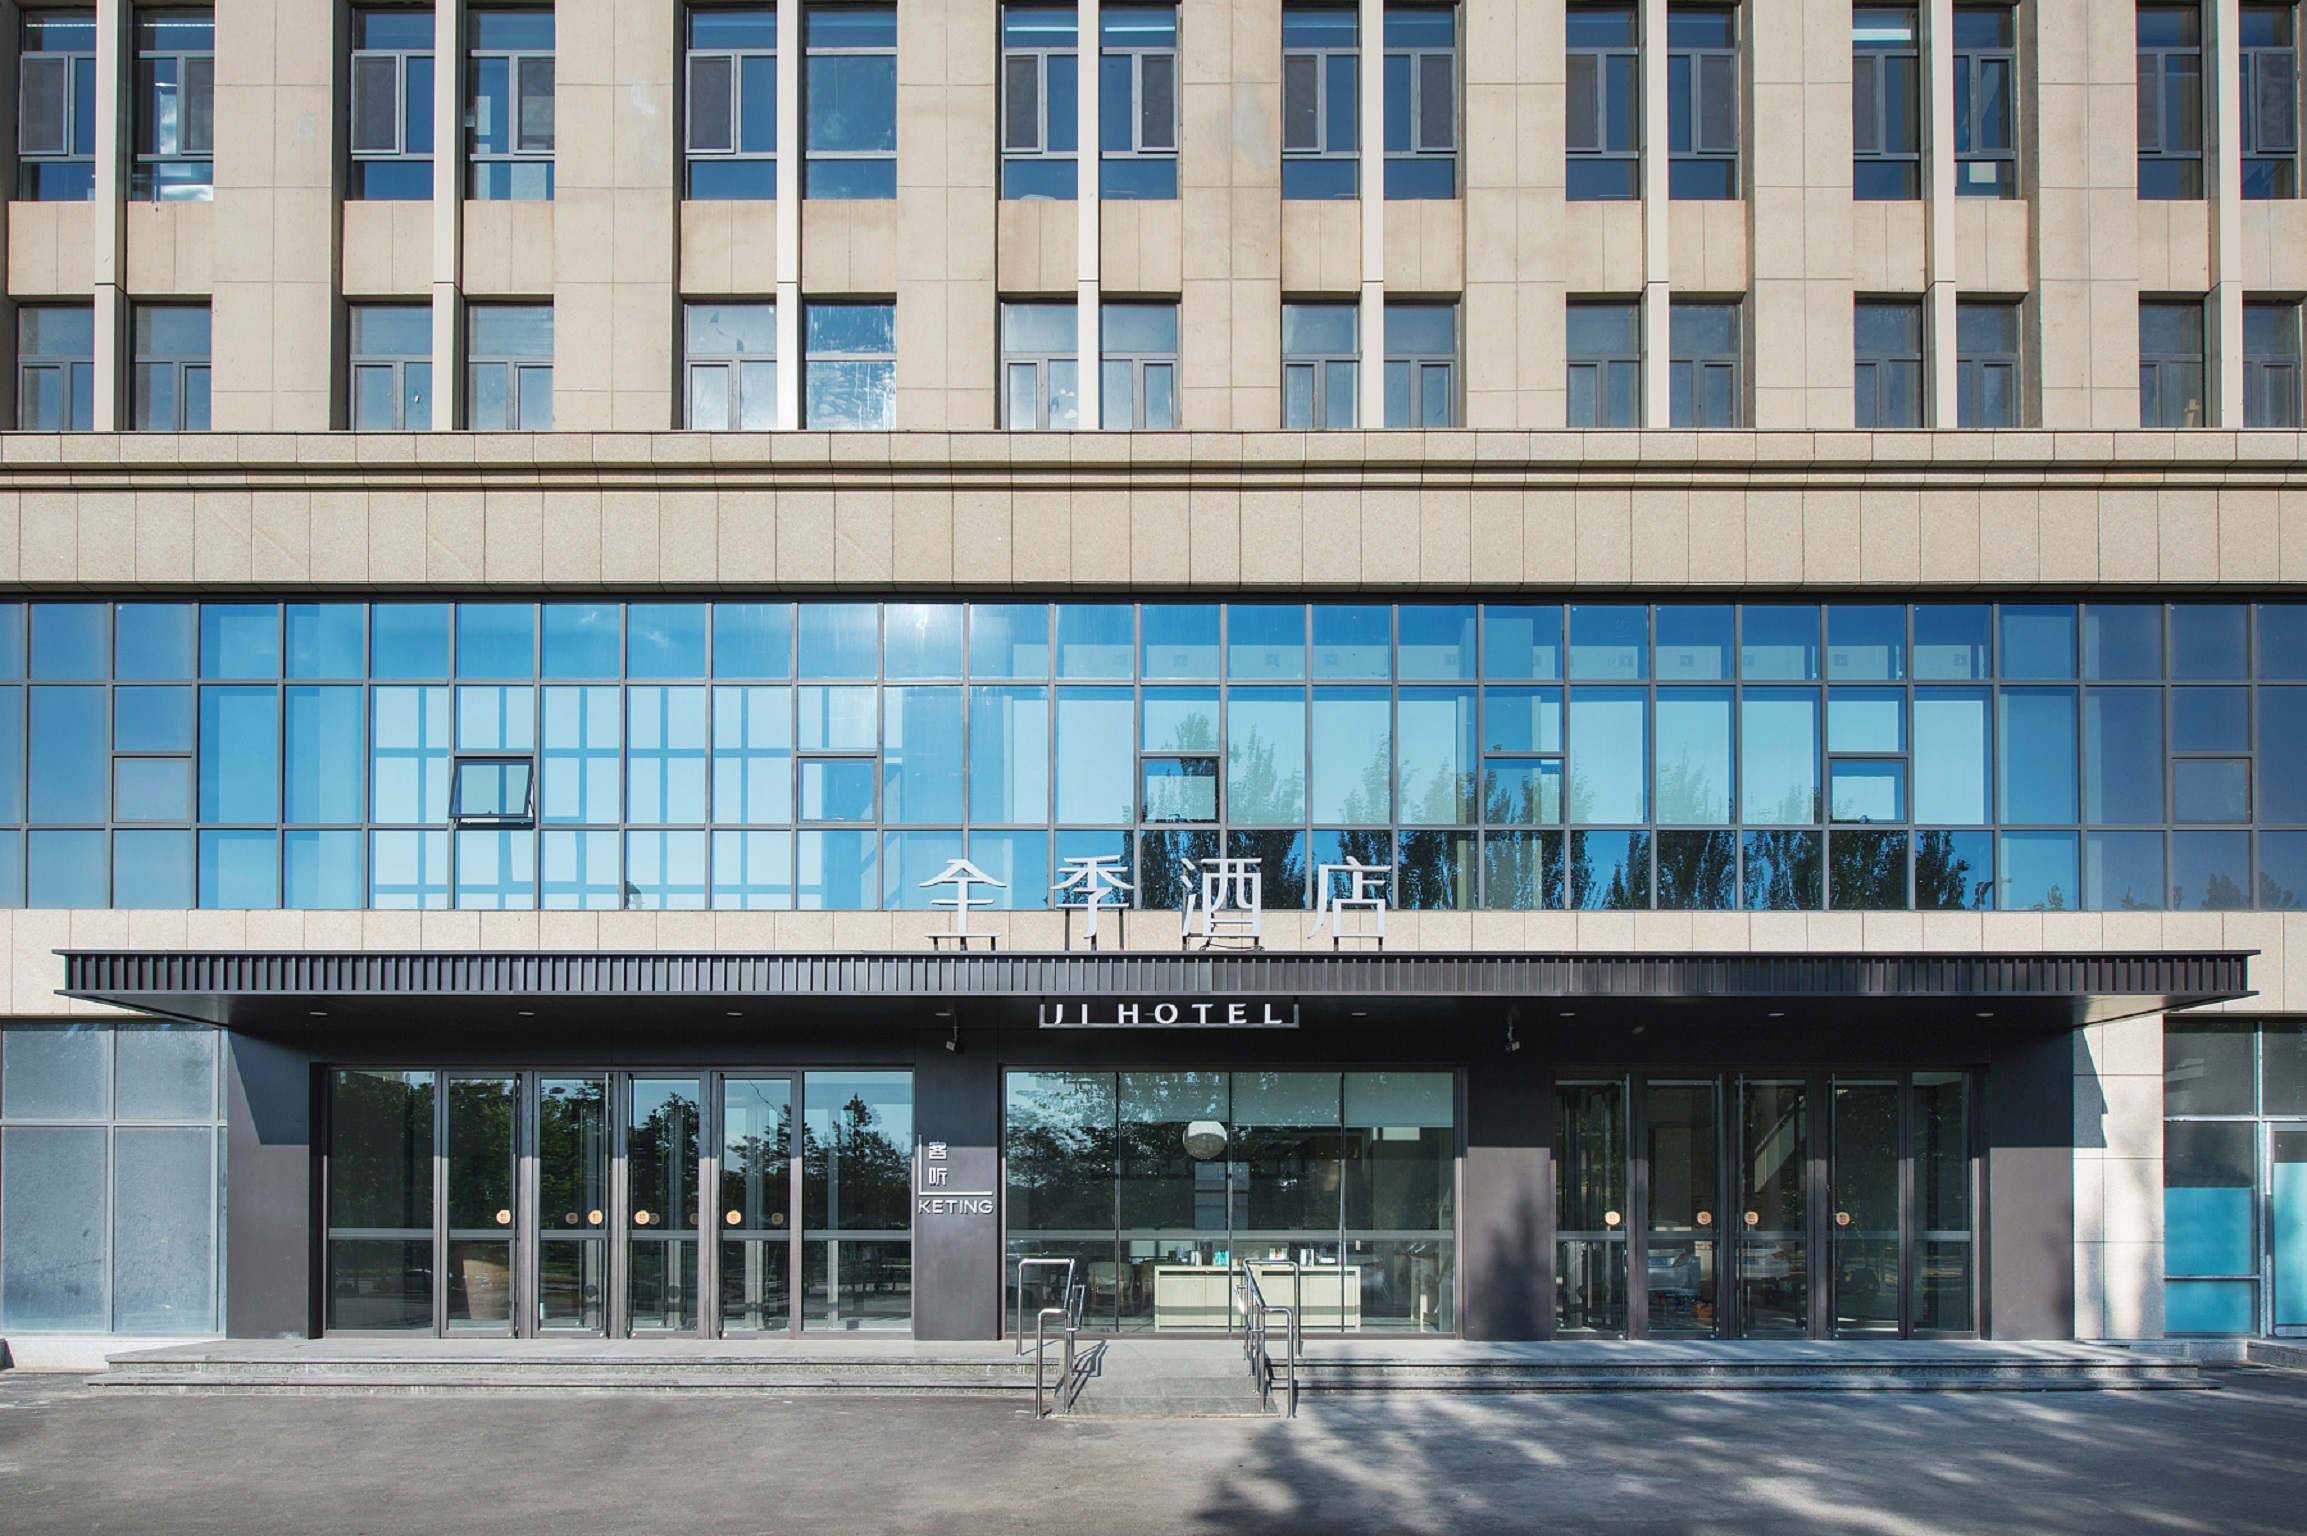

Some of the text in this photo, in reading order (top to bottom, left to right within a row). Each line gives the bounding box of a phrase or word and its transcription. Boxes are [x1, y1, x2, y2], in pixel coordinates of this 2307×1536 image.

[919, 855, 1392, 940] 全季酒店
[1054, 1003, 1283, 1025] JI HOTEL
[928, 1141, 948, 1186] 客听
[918, 1199, 993, 1214] KETING
